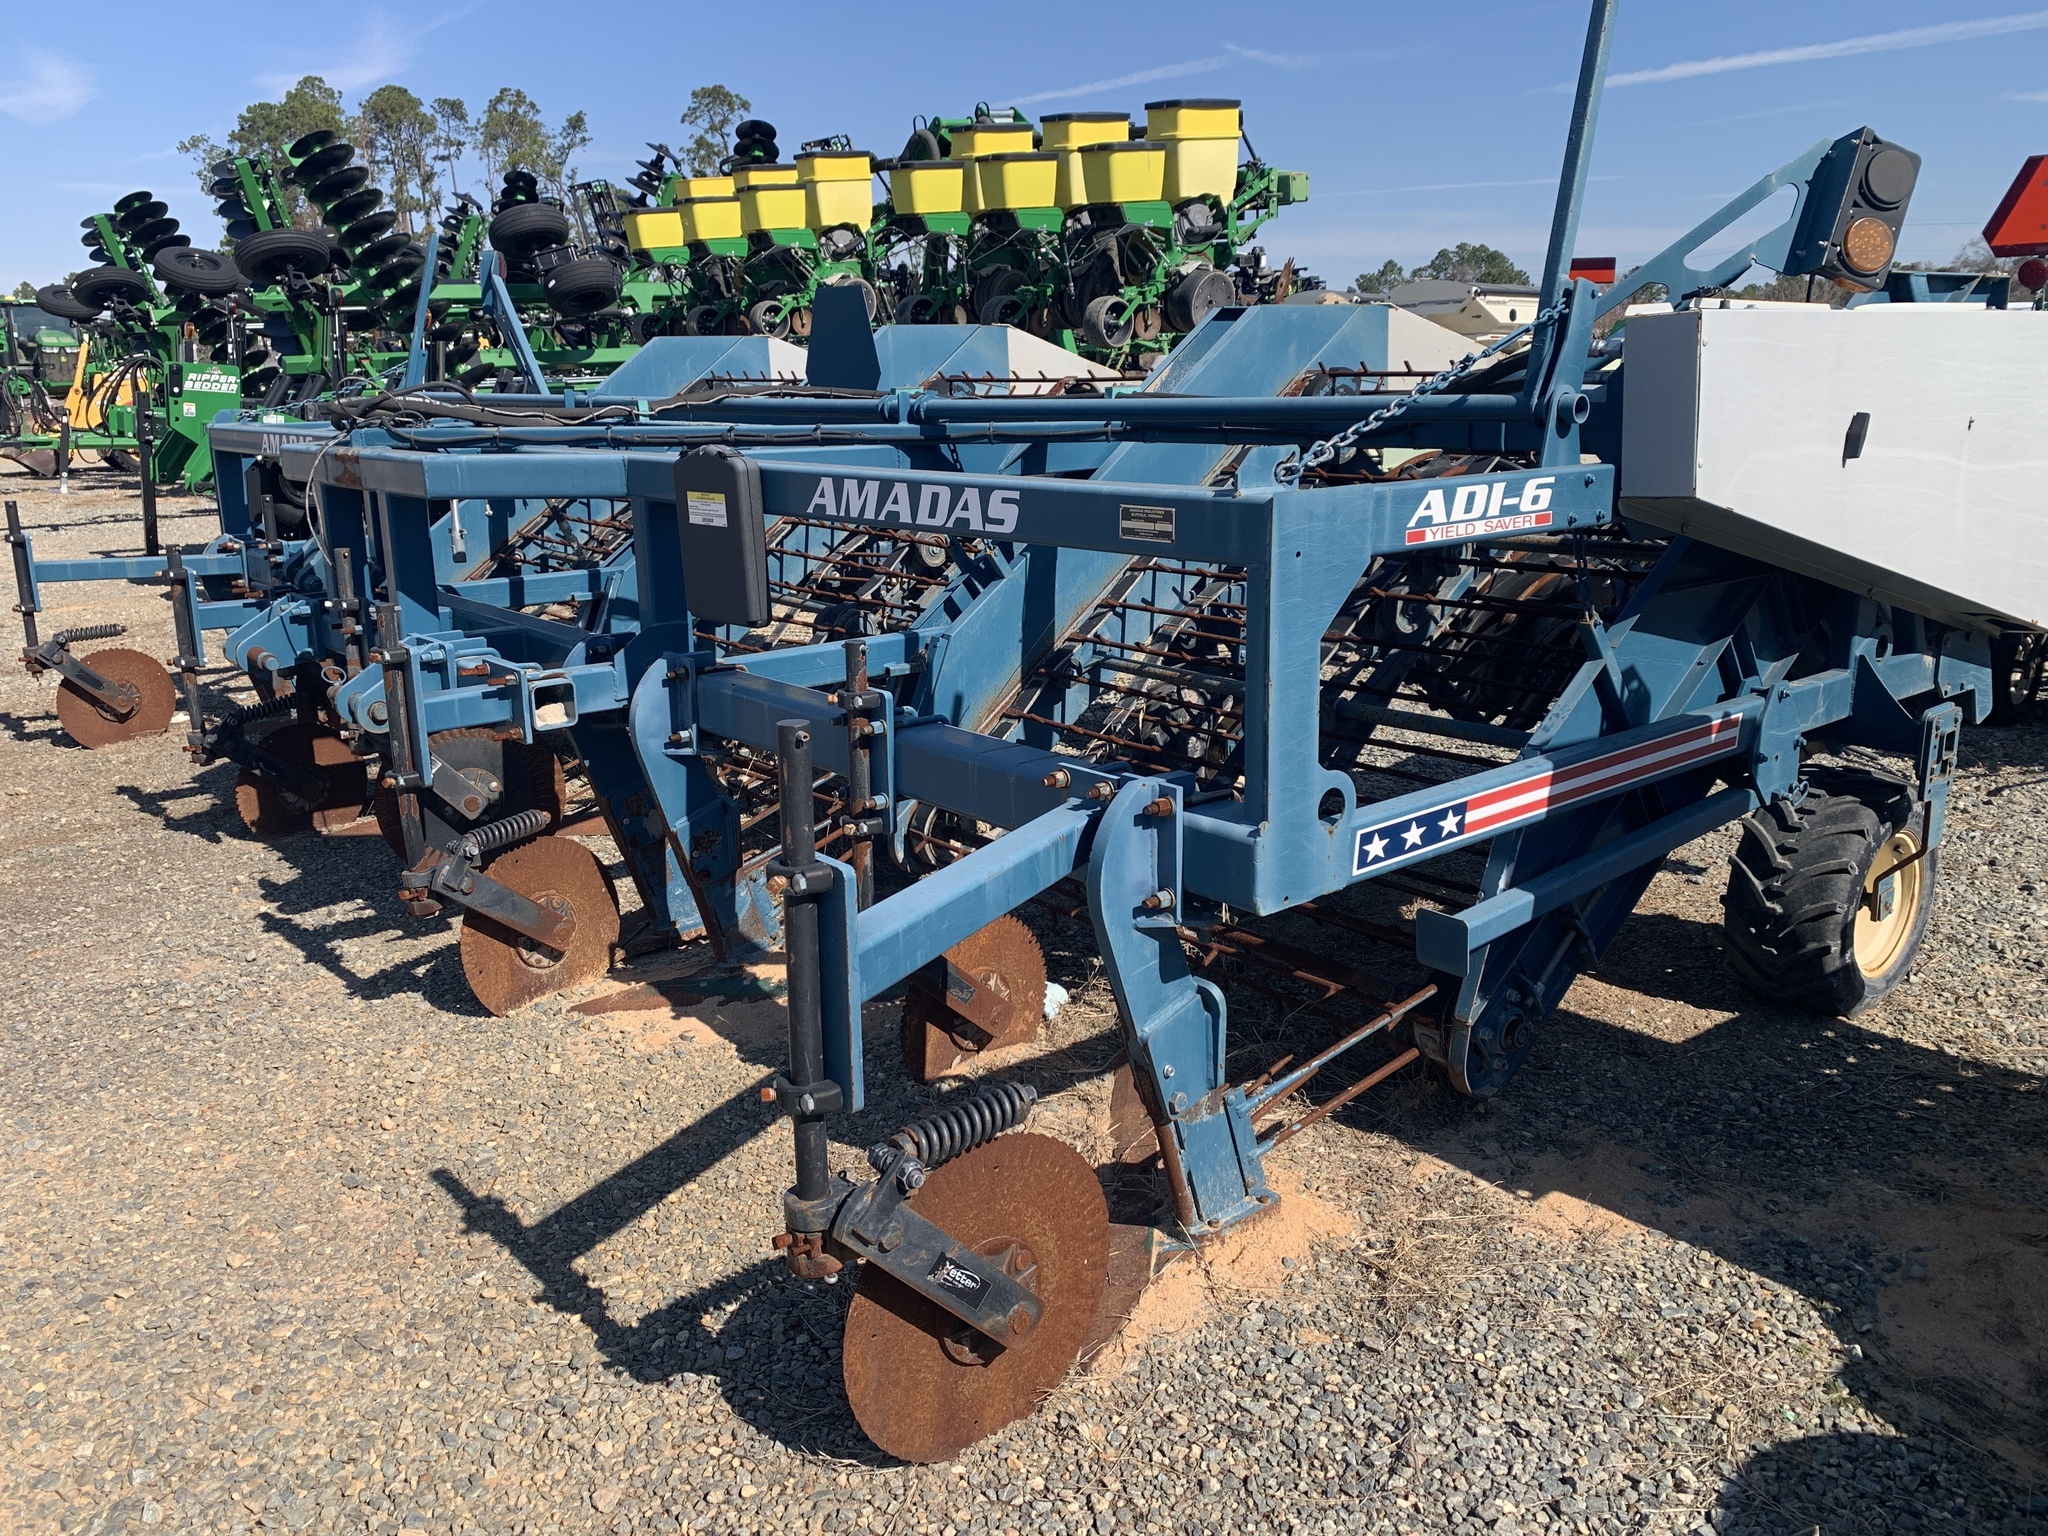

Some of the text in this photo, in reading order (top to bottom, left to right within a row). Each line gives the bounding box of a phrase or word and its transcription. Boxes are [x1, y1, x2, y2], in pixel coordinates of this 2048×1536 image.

[184, 381, 238, 392] BEDDER
[187, 373, 240, 384] RIPPER-
[806, 476, 1021, 534] AMADAS
[1406, 476, 1556, 528] ADI-6
[1429, 515, 1533, 540] YIELD SAVER
